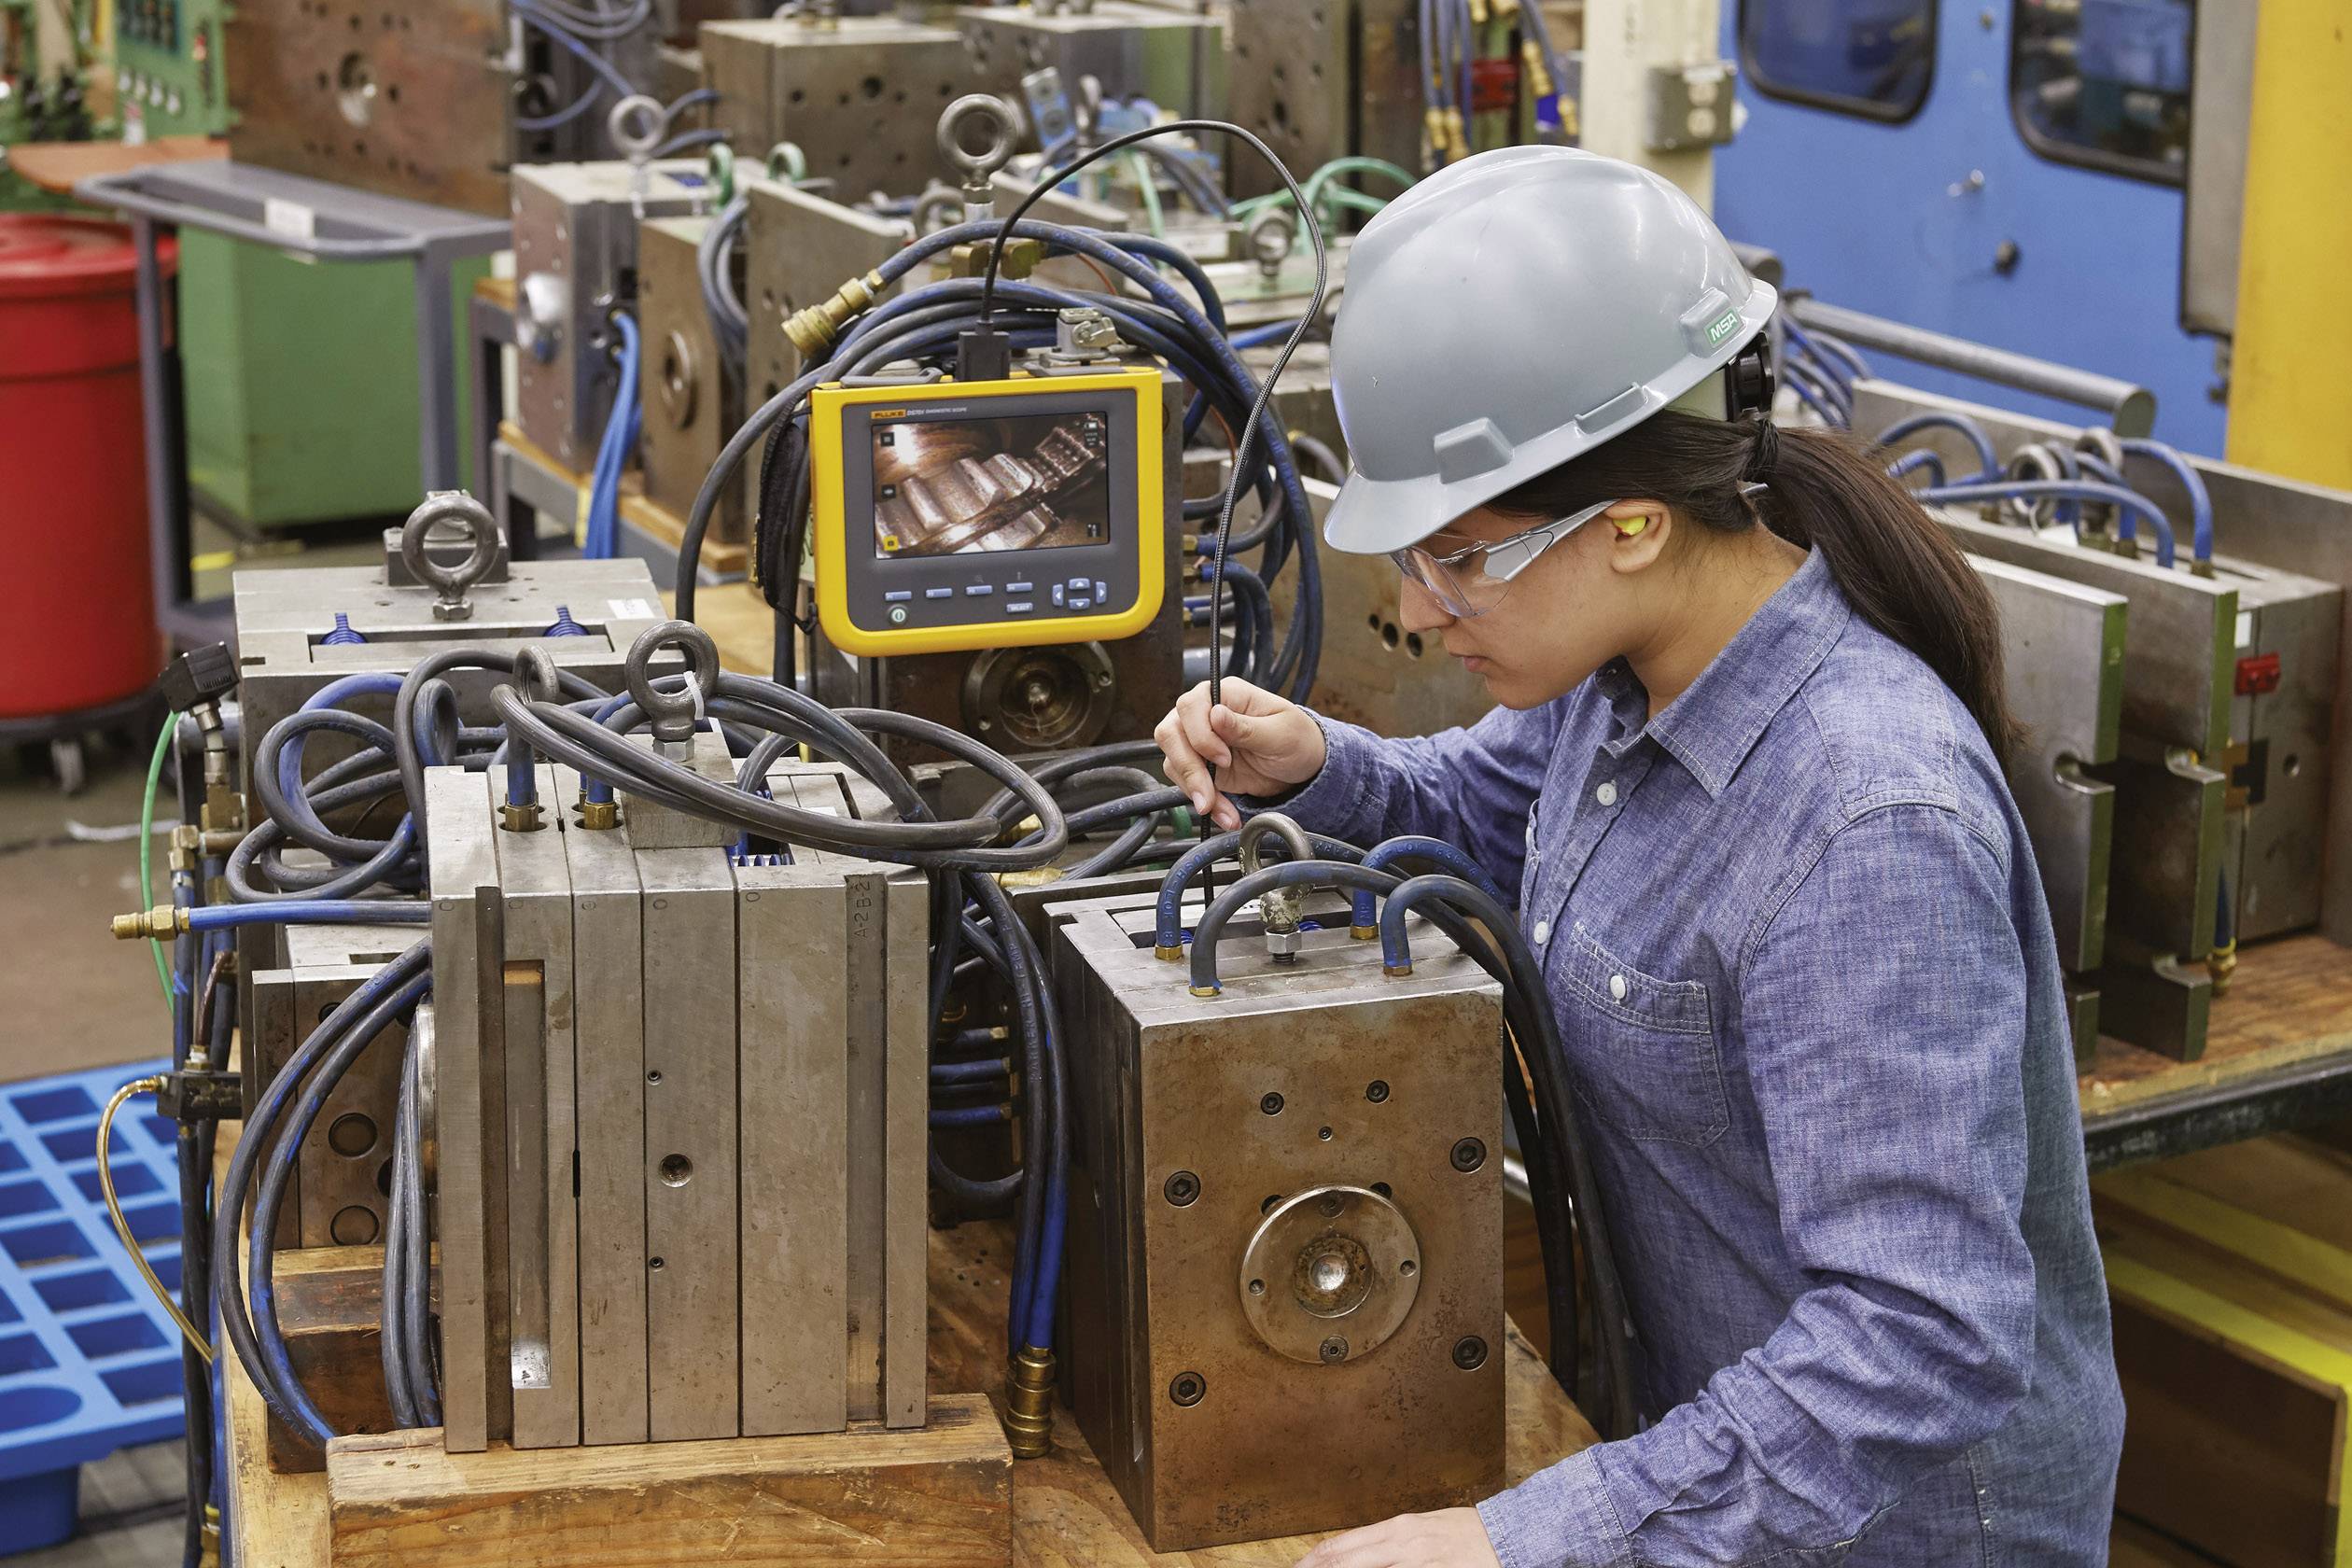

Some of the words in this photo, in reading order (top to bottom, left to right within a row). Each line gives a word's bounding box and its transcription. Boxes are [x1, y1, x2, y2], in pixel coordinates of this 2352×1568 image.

[1710, 313, 1738, 342] MSA
[853, 910, 870, 940] A-2
[1025, 1020, 1041, 1083] PARKER
